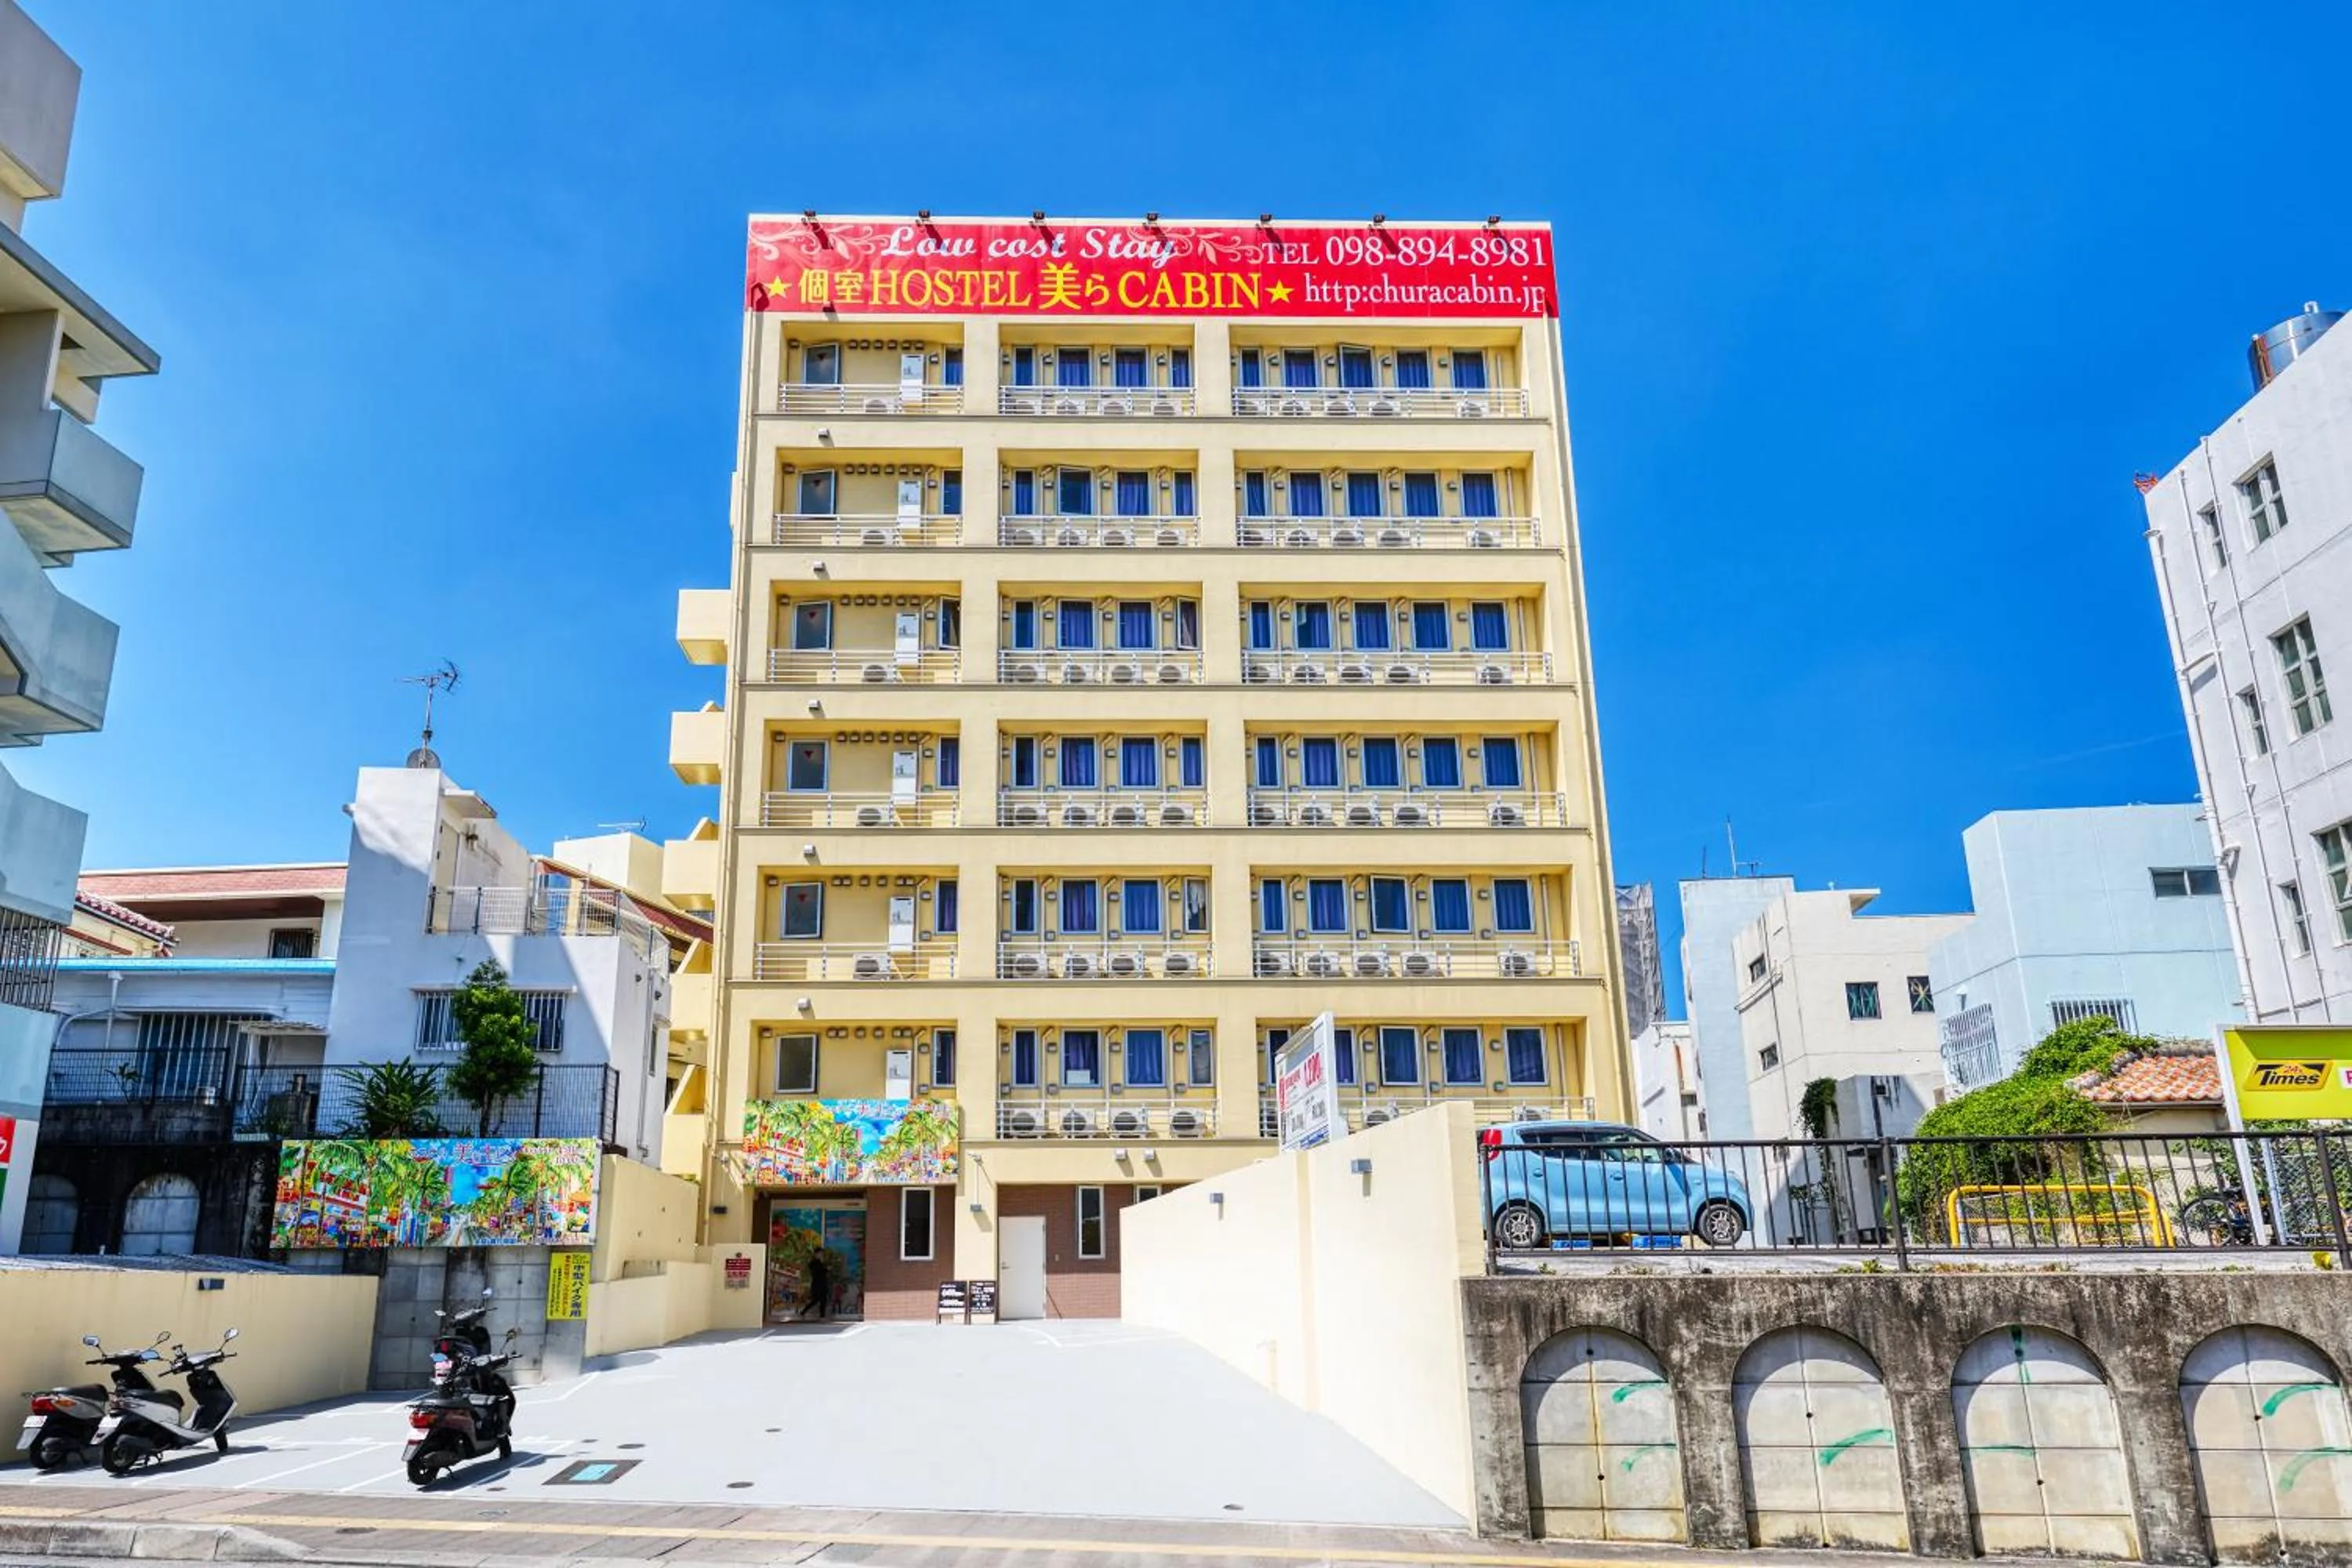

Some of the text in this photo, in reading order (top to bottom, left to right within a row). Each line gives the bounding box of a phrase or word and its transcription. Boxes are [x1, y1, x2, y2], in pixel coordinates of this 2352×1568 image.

[881, 226, 1176, 269] Low cost Stay
[1261, 235, 1548, 267] TEL 098-894-8981
[1304, 271, 1546, 313] http:churacabin.jp
[2256, 1064, 2320, 1086] Times
